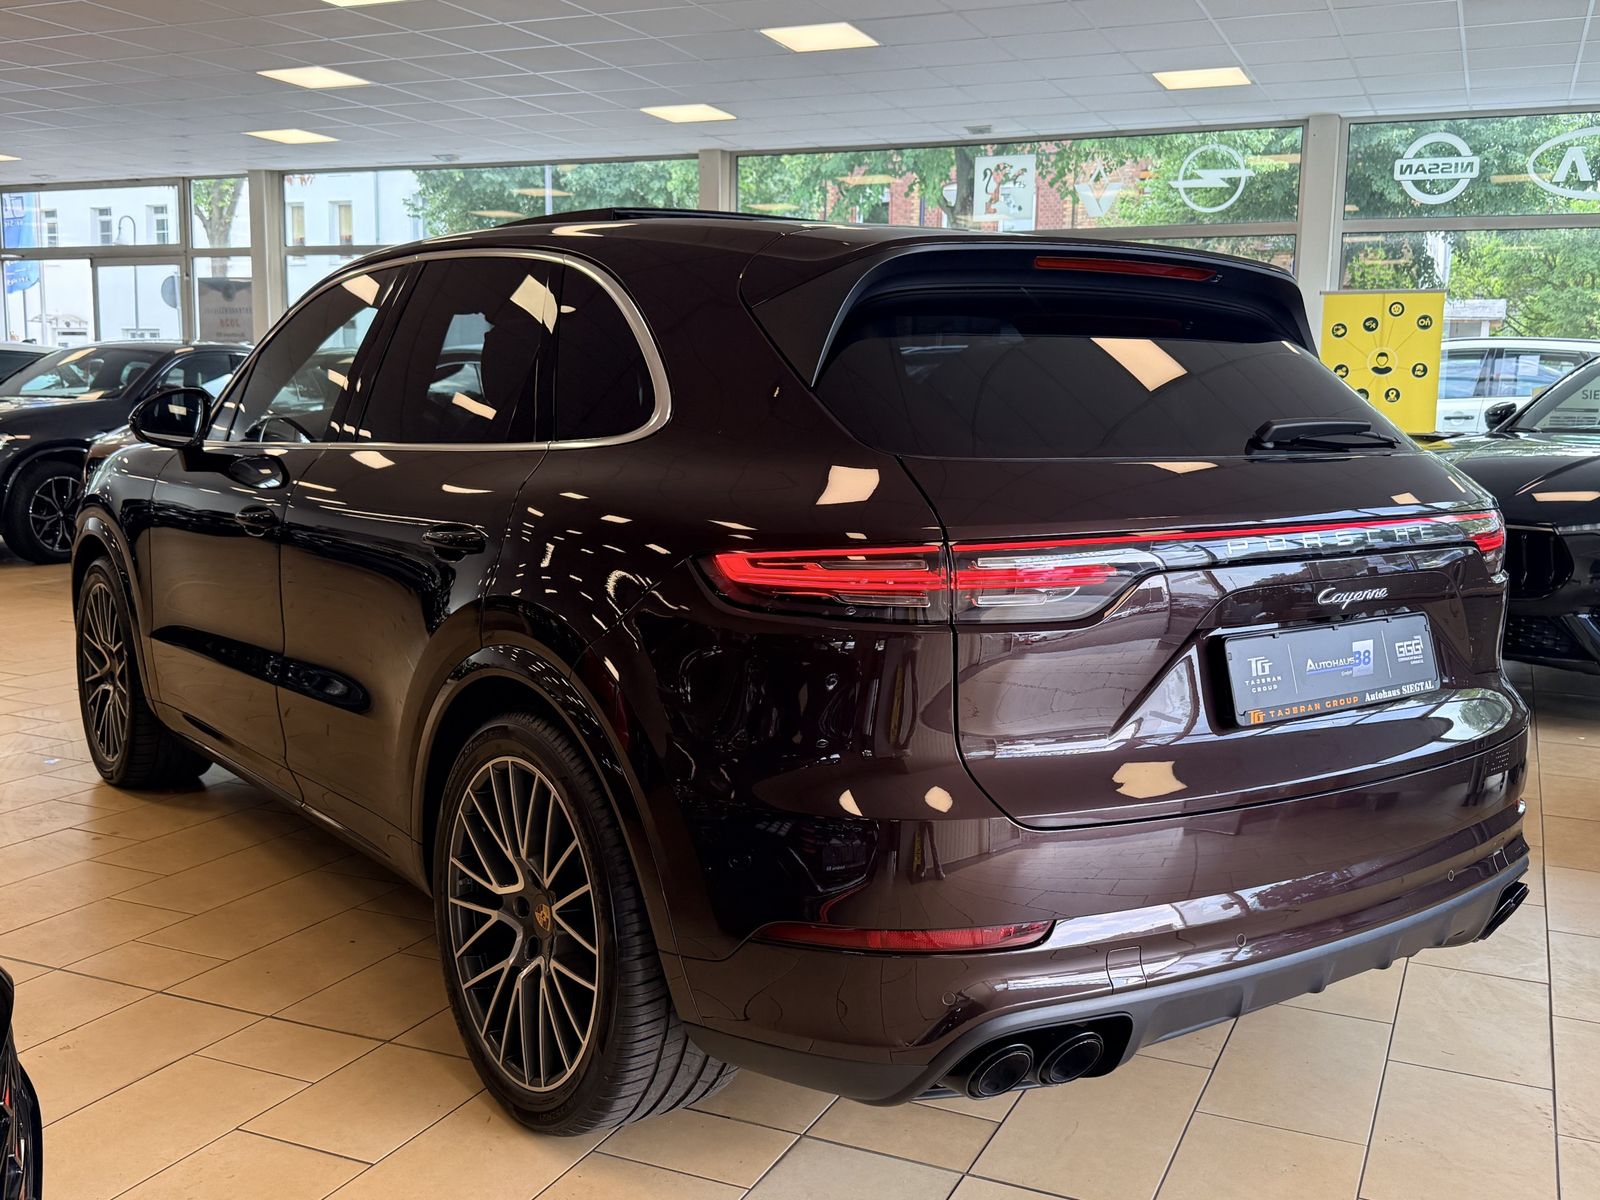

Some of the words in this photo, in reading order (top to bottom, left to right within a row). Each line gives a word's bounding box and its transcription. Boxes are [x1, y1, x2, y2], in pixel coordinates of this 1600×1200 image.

[1226, 525, 1432, 555] PORSCHE
[1317, 587, 1389, 610] Cayenne
[1251, 684, 1278, 693] GROUP
[1325, 696, 1359, 708] GROUP
[1365, 688, 1401, 702] Autohaus
[1401, 680, 1434, 695] SIEGTAL
